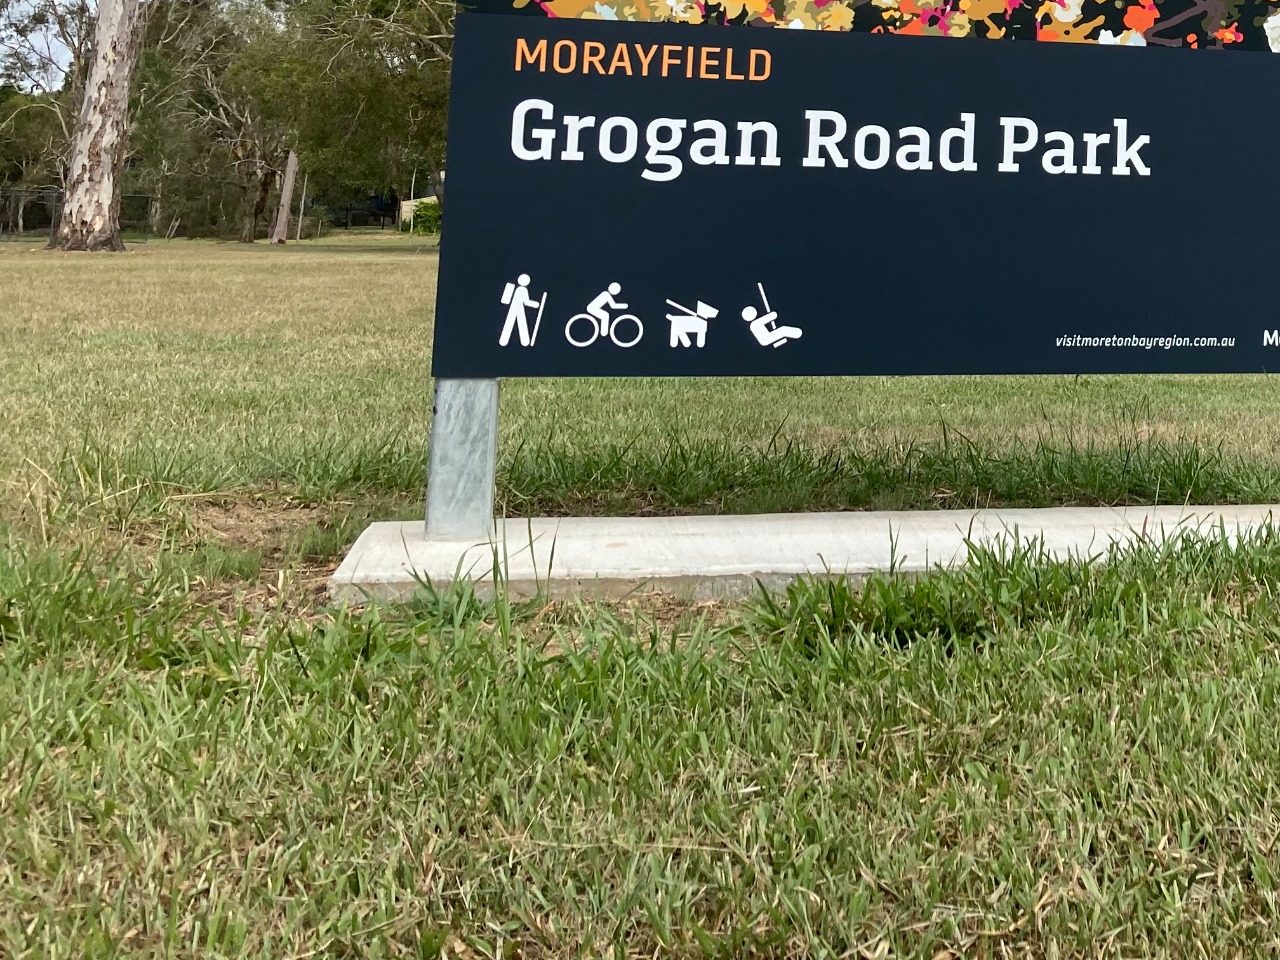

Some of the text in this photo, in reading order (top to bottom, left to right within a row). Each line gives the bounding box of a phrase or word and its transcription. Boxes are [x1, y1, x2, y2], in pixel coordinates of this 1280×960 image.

[514, 38, 773, 82] MORAYFIELD
[510, 98, 1152, 182] Grogan Road Park
[1055, 334, 1236, 350] visitmoretonbayregion.com.au
